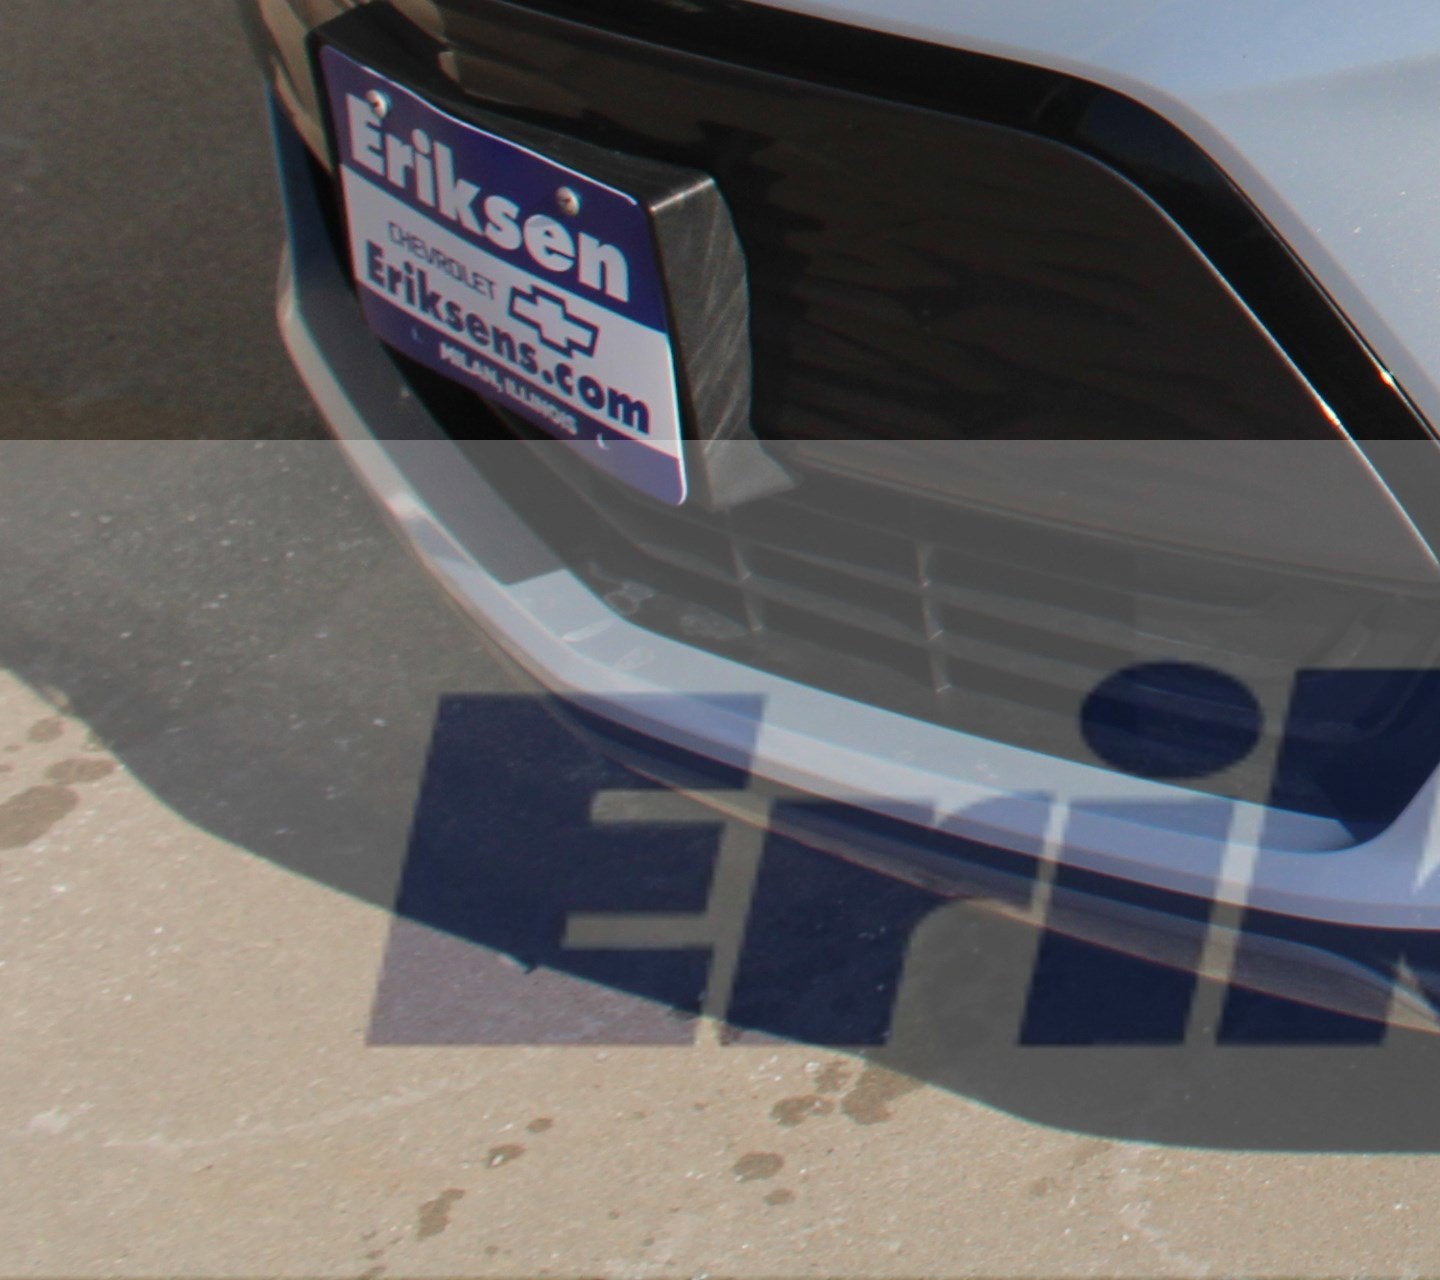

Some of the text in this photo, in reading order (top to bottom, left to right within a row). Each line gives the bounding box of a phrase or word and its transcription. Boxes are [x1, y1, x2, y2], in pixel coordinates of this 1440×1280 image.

[345, 92, 630, 303] Eriksen
[388, 222, 496, 301] CHEVROLET
[367, 240, 650, 435] Eriksens.com
